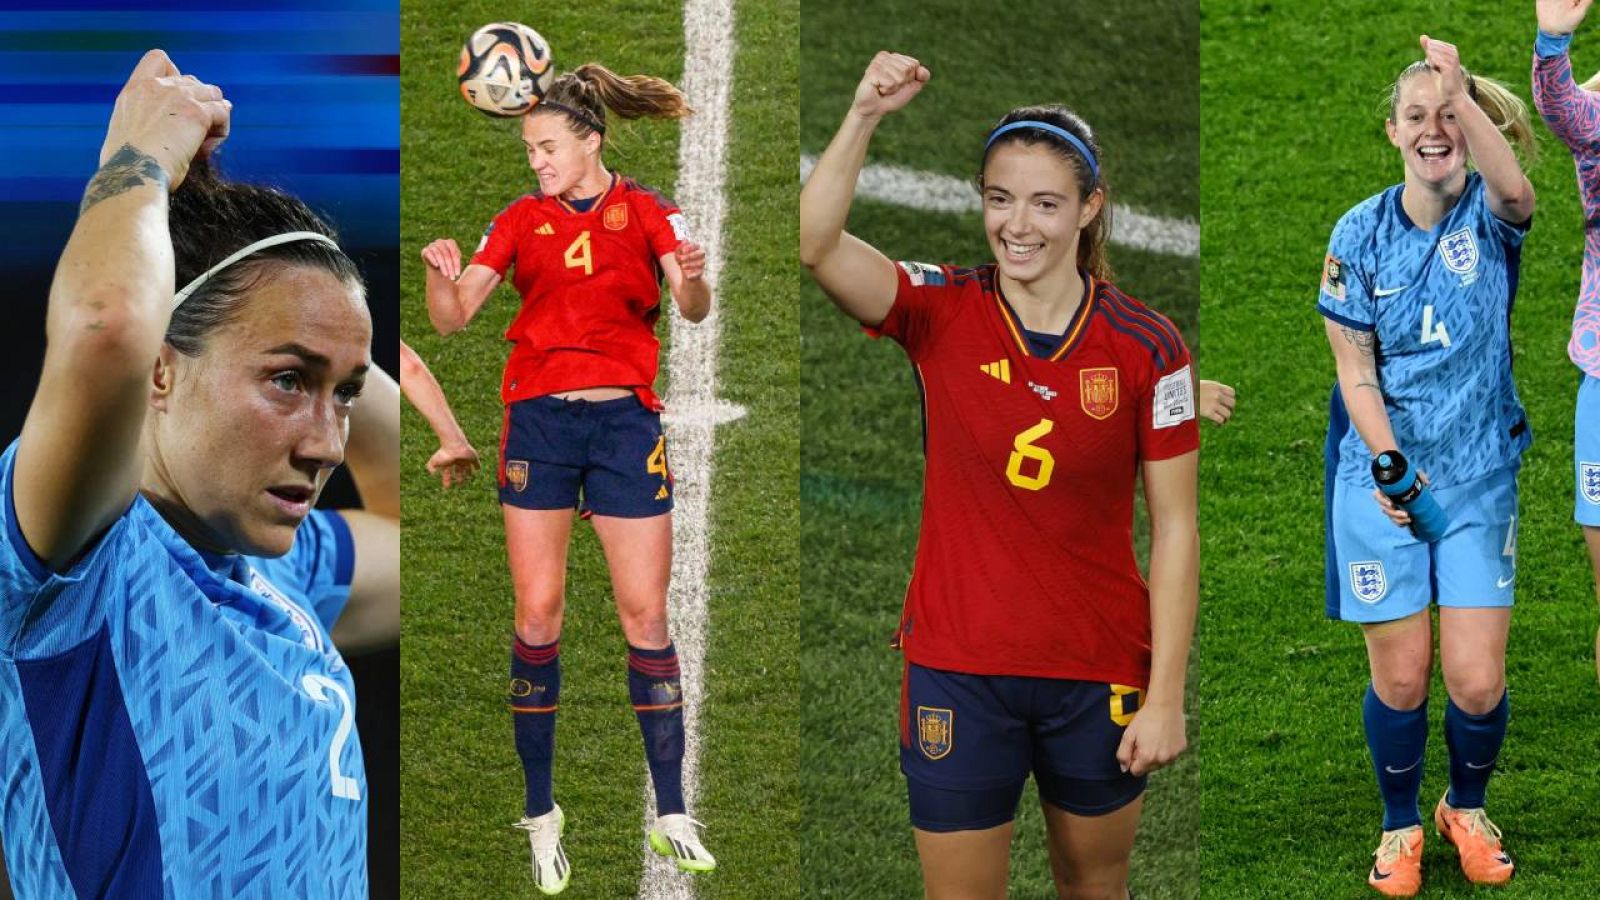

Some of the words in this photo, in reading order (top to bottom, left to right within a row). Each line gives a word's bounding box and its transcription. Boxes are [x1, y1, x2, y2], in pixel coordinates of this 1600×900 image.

[564, 230, 593, 276] 4
[1420, 304, 1452, 349] 4
[646, 434, 667, 480] 4
[1005, 418, 1055, 491] 6
[302, 674, 361, 801] 2
